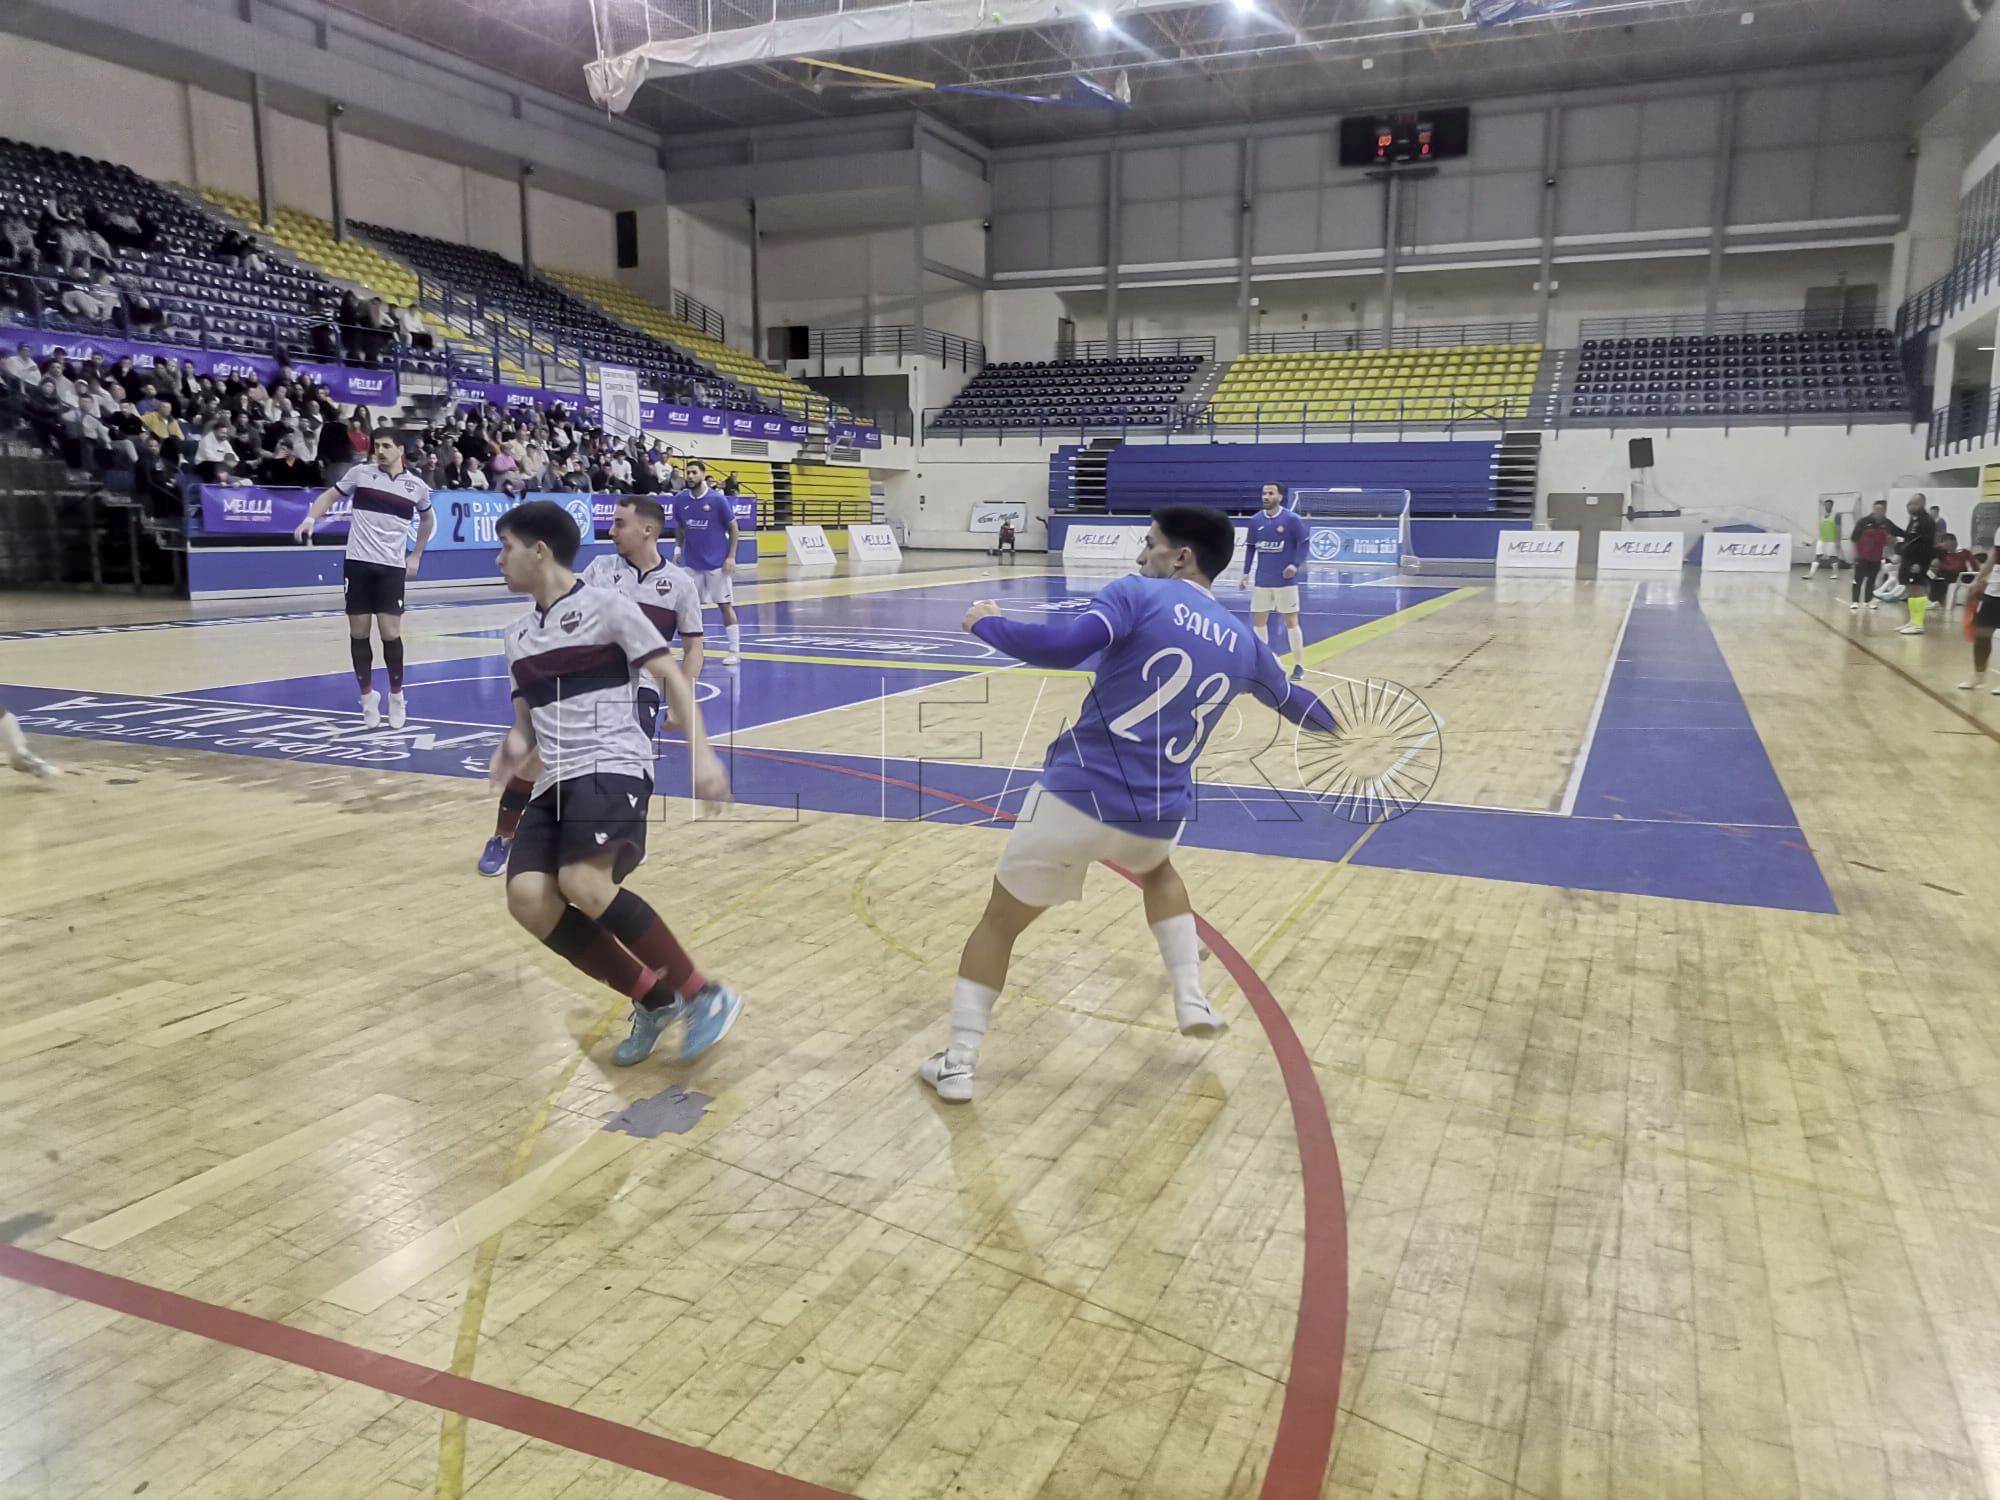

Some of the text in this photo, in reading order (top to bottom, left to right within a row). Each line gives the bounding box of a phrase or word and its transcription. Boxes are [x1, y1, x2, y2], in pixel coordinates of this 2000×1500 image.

[223, 499, 273, 514] MELILLA
[472, 502, 520, 513] DIVI
[474, 512, 499, 542] FÚT
[1075, 534, 1121, 546] MELILLA
[1507, 541, 1564, 553] MELILLA
[1613, 541, 1673, 554] MELILLA
[1717, 543, 1780, 556] MELILLA
[1173, 603, 1239, 653] SALVI
[1109, 647, 1231, 764] 23
[15, 714, 224, 741] AUTÓNO
[23, 696, 503, 750] MELILLA
[213, 736, 411, 761] CIUDAD
